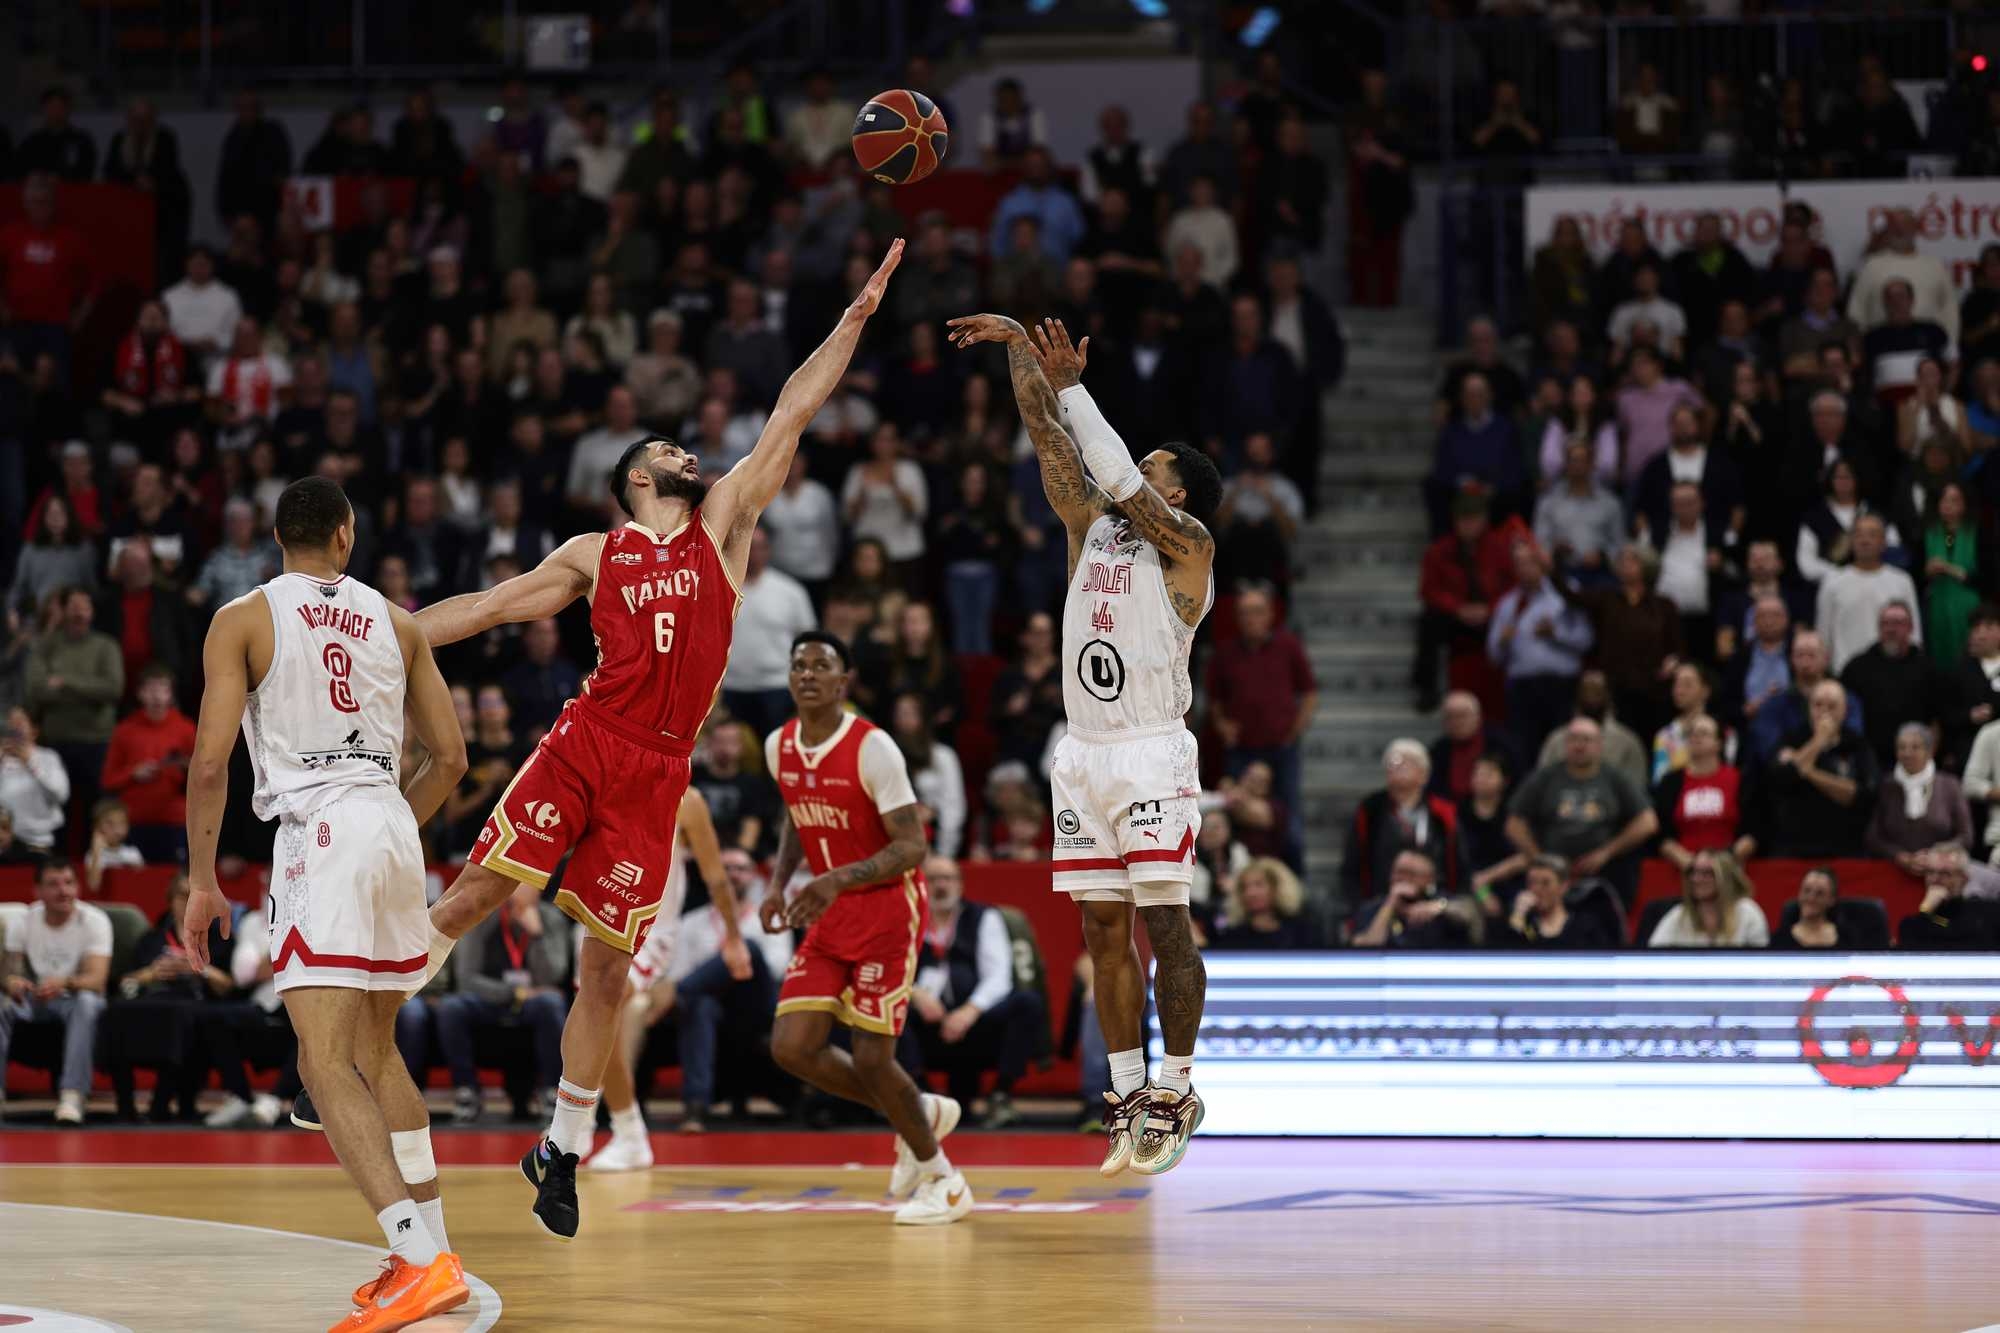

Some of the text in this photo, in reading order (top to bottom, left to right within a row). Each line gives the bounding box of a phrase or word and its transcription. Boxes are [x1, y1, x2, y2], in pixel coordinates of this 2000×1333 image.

[1552, 197, 1822, 244] métropo
[621, 568, 699, 615] NANCY
[655, 612, 675, 653] 6
[323, 642, 361, 713] 8
[789, 803, 849, 829] NANCY
[1130, 817, 1163, 828] CHOLET
[317, 822, 331, 847] 8
[596, 876, 642, 905] EIFFAGE
